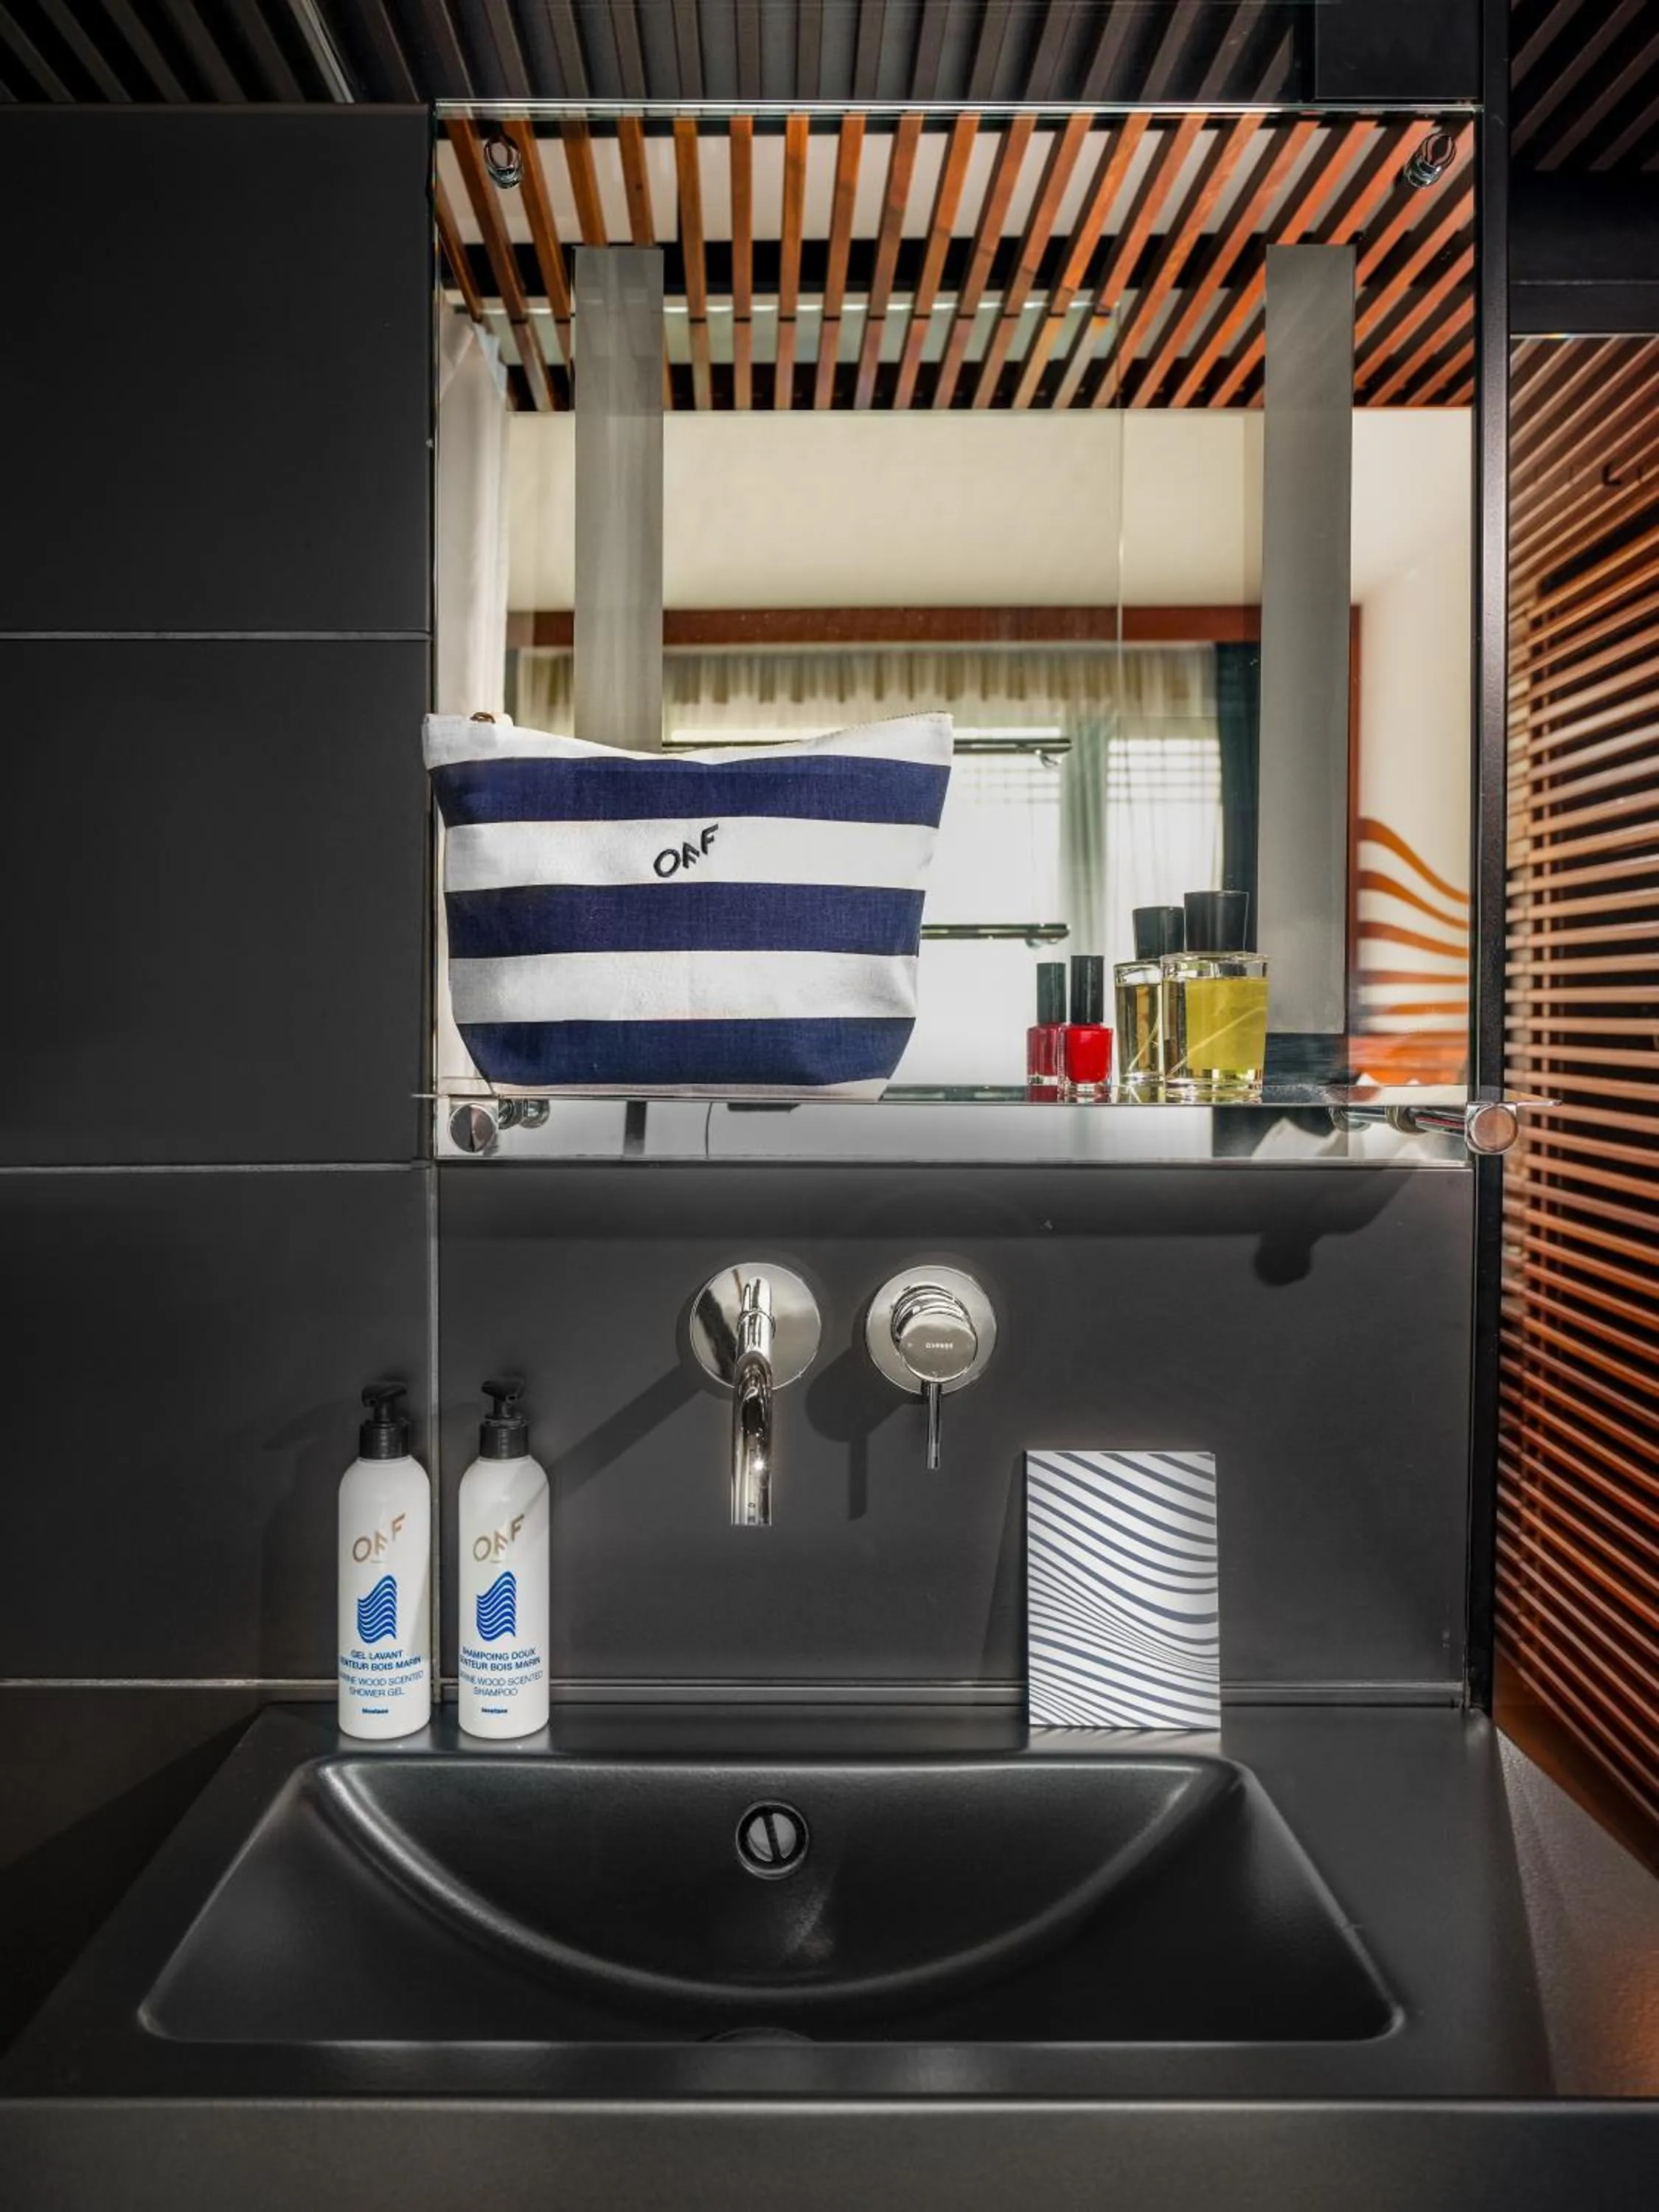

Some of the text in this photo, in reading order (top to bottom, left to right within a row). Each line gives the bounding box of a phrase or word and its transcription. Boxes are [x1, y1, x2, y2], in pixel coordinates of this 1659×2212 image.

[351, 1649, 403, 1660] GEL LAVANT
[511, 1647, 535, 1660] DOUX
[371, 1663, 393, 1671] BOIS
[395, 1656, 421, 1669] MARIN
[490, 1663, 512, 1672] BOIS
[515, 1656, 540, 1669] MARIN
[358, 1677, 386, 1686] WOOD
[389, 1670, 423, 1686] SCENTED
[478, 1677, 505, 1686] WOOD
[507, 1670, 543, 1686] SCENTED
[349, 1686, 406, 1697] SHOWER GEL
[473, 1686, 518, 1697] SHAMPOO
